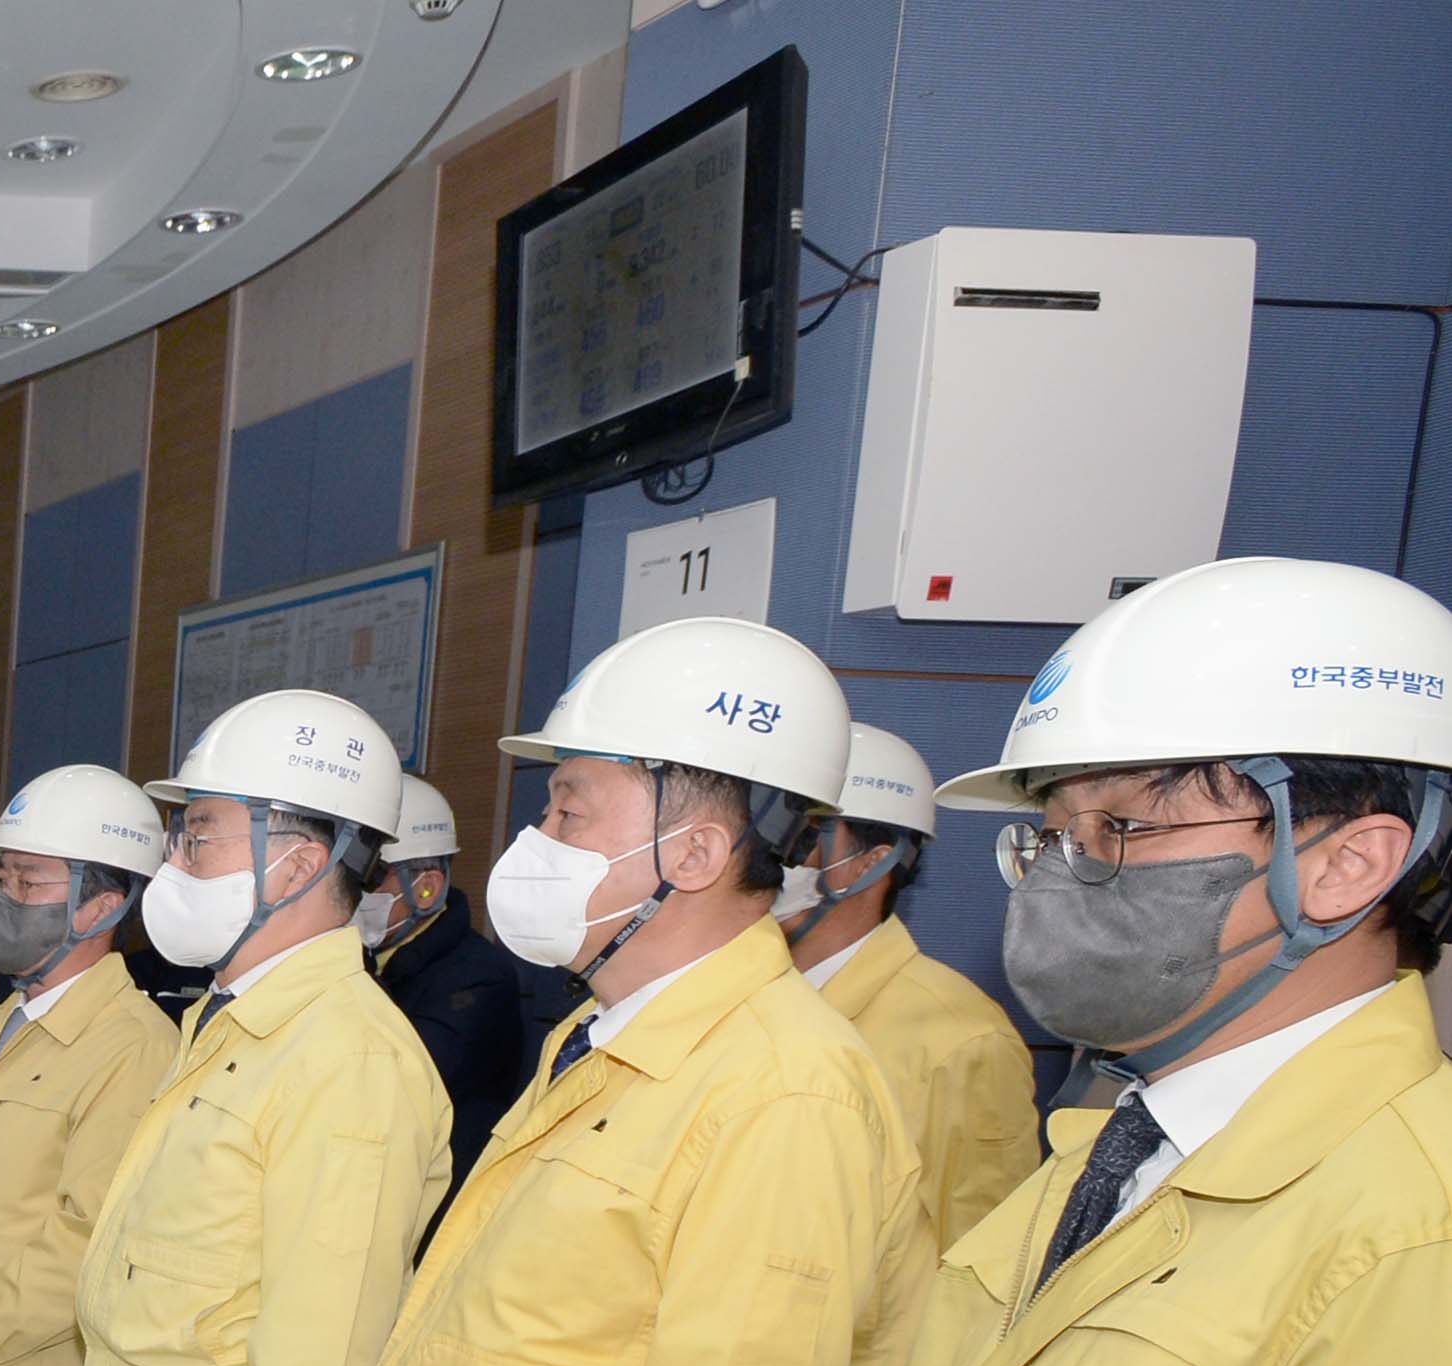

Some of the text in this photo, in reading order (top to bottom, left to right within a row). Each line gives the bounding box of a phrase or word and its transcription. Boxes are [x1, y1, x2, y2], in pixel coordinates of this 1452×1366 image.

[679, 546, 711, 596] 11
[1290, 664, 1445, 701] 한국중부발전
[704, 689, 783, 735] 사장
[1015, 706, 1060, 733] OMIPO
[294, 724, 365, 762] 장 관
[287, 753, 362, 784] 한국중부발전
[851, 774, 916, 797] 한국중부발전
[101, 822, 152, 846] 한국중부발전
